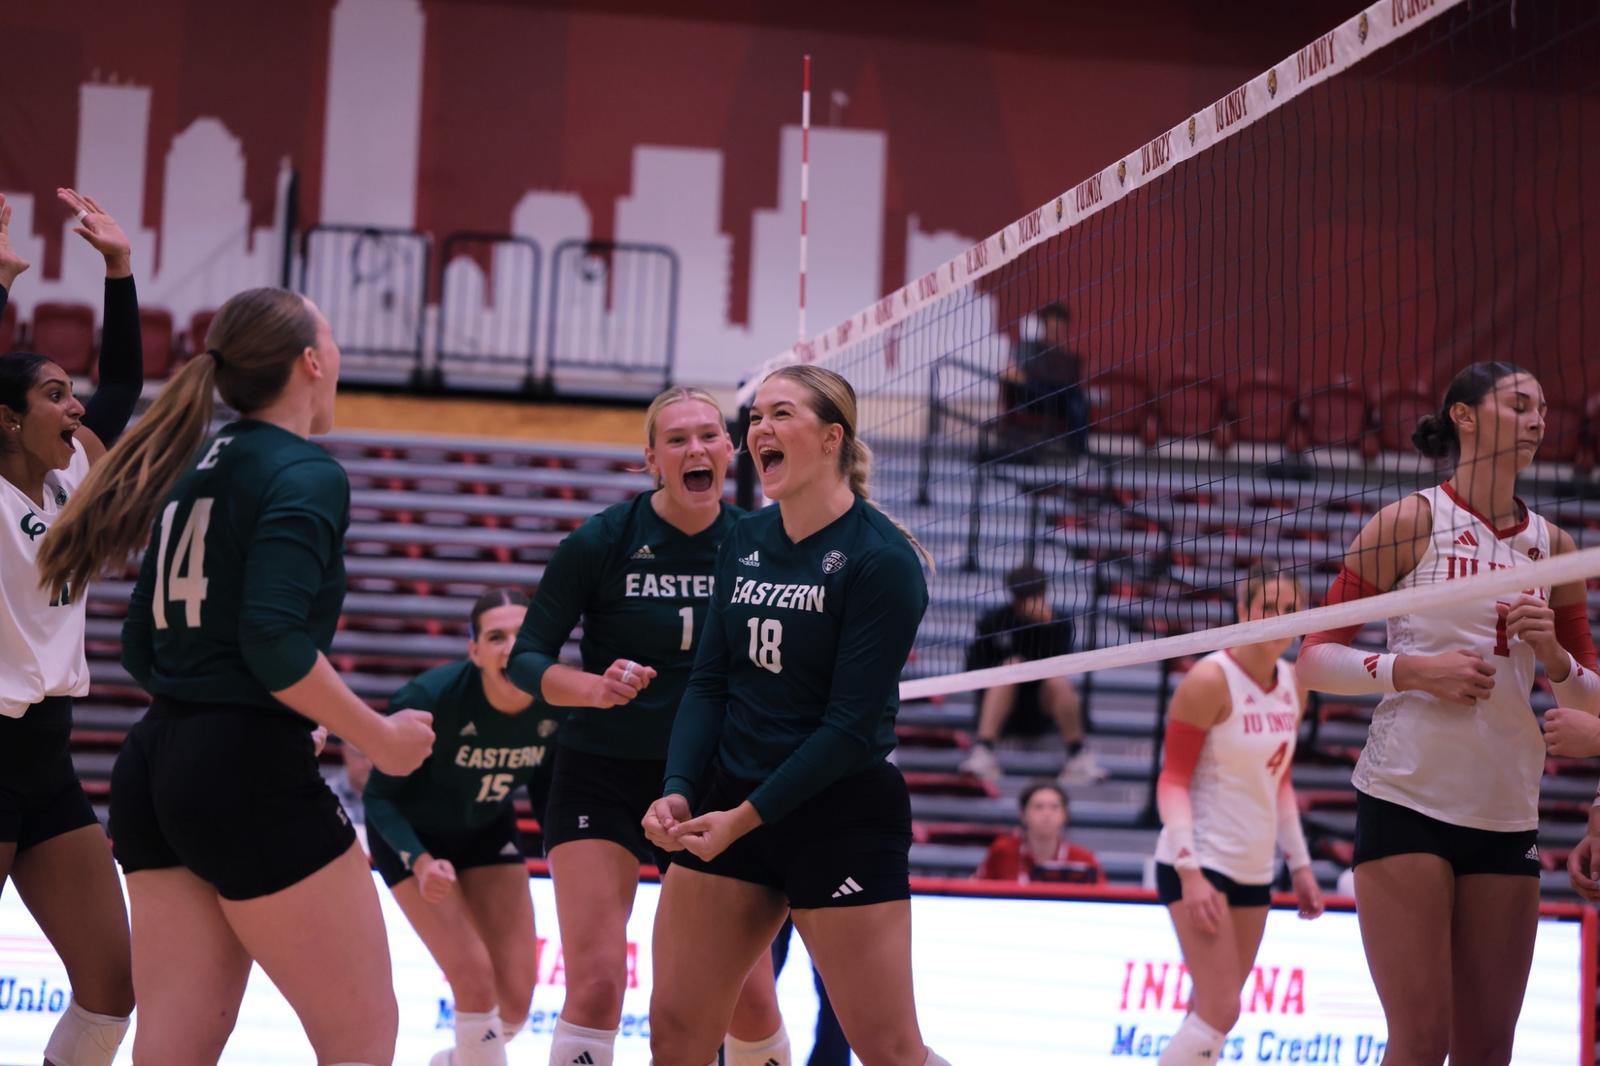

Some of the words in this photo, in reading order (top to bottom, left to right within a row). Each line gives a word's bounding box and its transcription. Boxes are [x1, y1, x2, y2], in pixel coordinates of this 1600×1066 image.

[196, 436, 234, 470] E
[152, 498, 209, 629] 14
[730, 576, 826, 613] EASTERN
[678, 607, 694, 651] 1
[747, 617, 783, 674] 18
[1243, 714, 1263, 734] IU
[455, 744, 546, 769] EASTERN
[1266, 741, 1289, 776] 4
[476, 773, 514, 802] 15
[578, 815, 589, 828] E
[0, 976, 74, 1013] Unio
[1119, 962, 1305, 1015] INDNA
[1258, 1031, 1342, 1064] Credit
